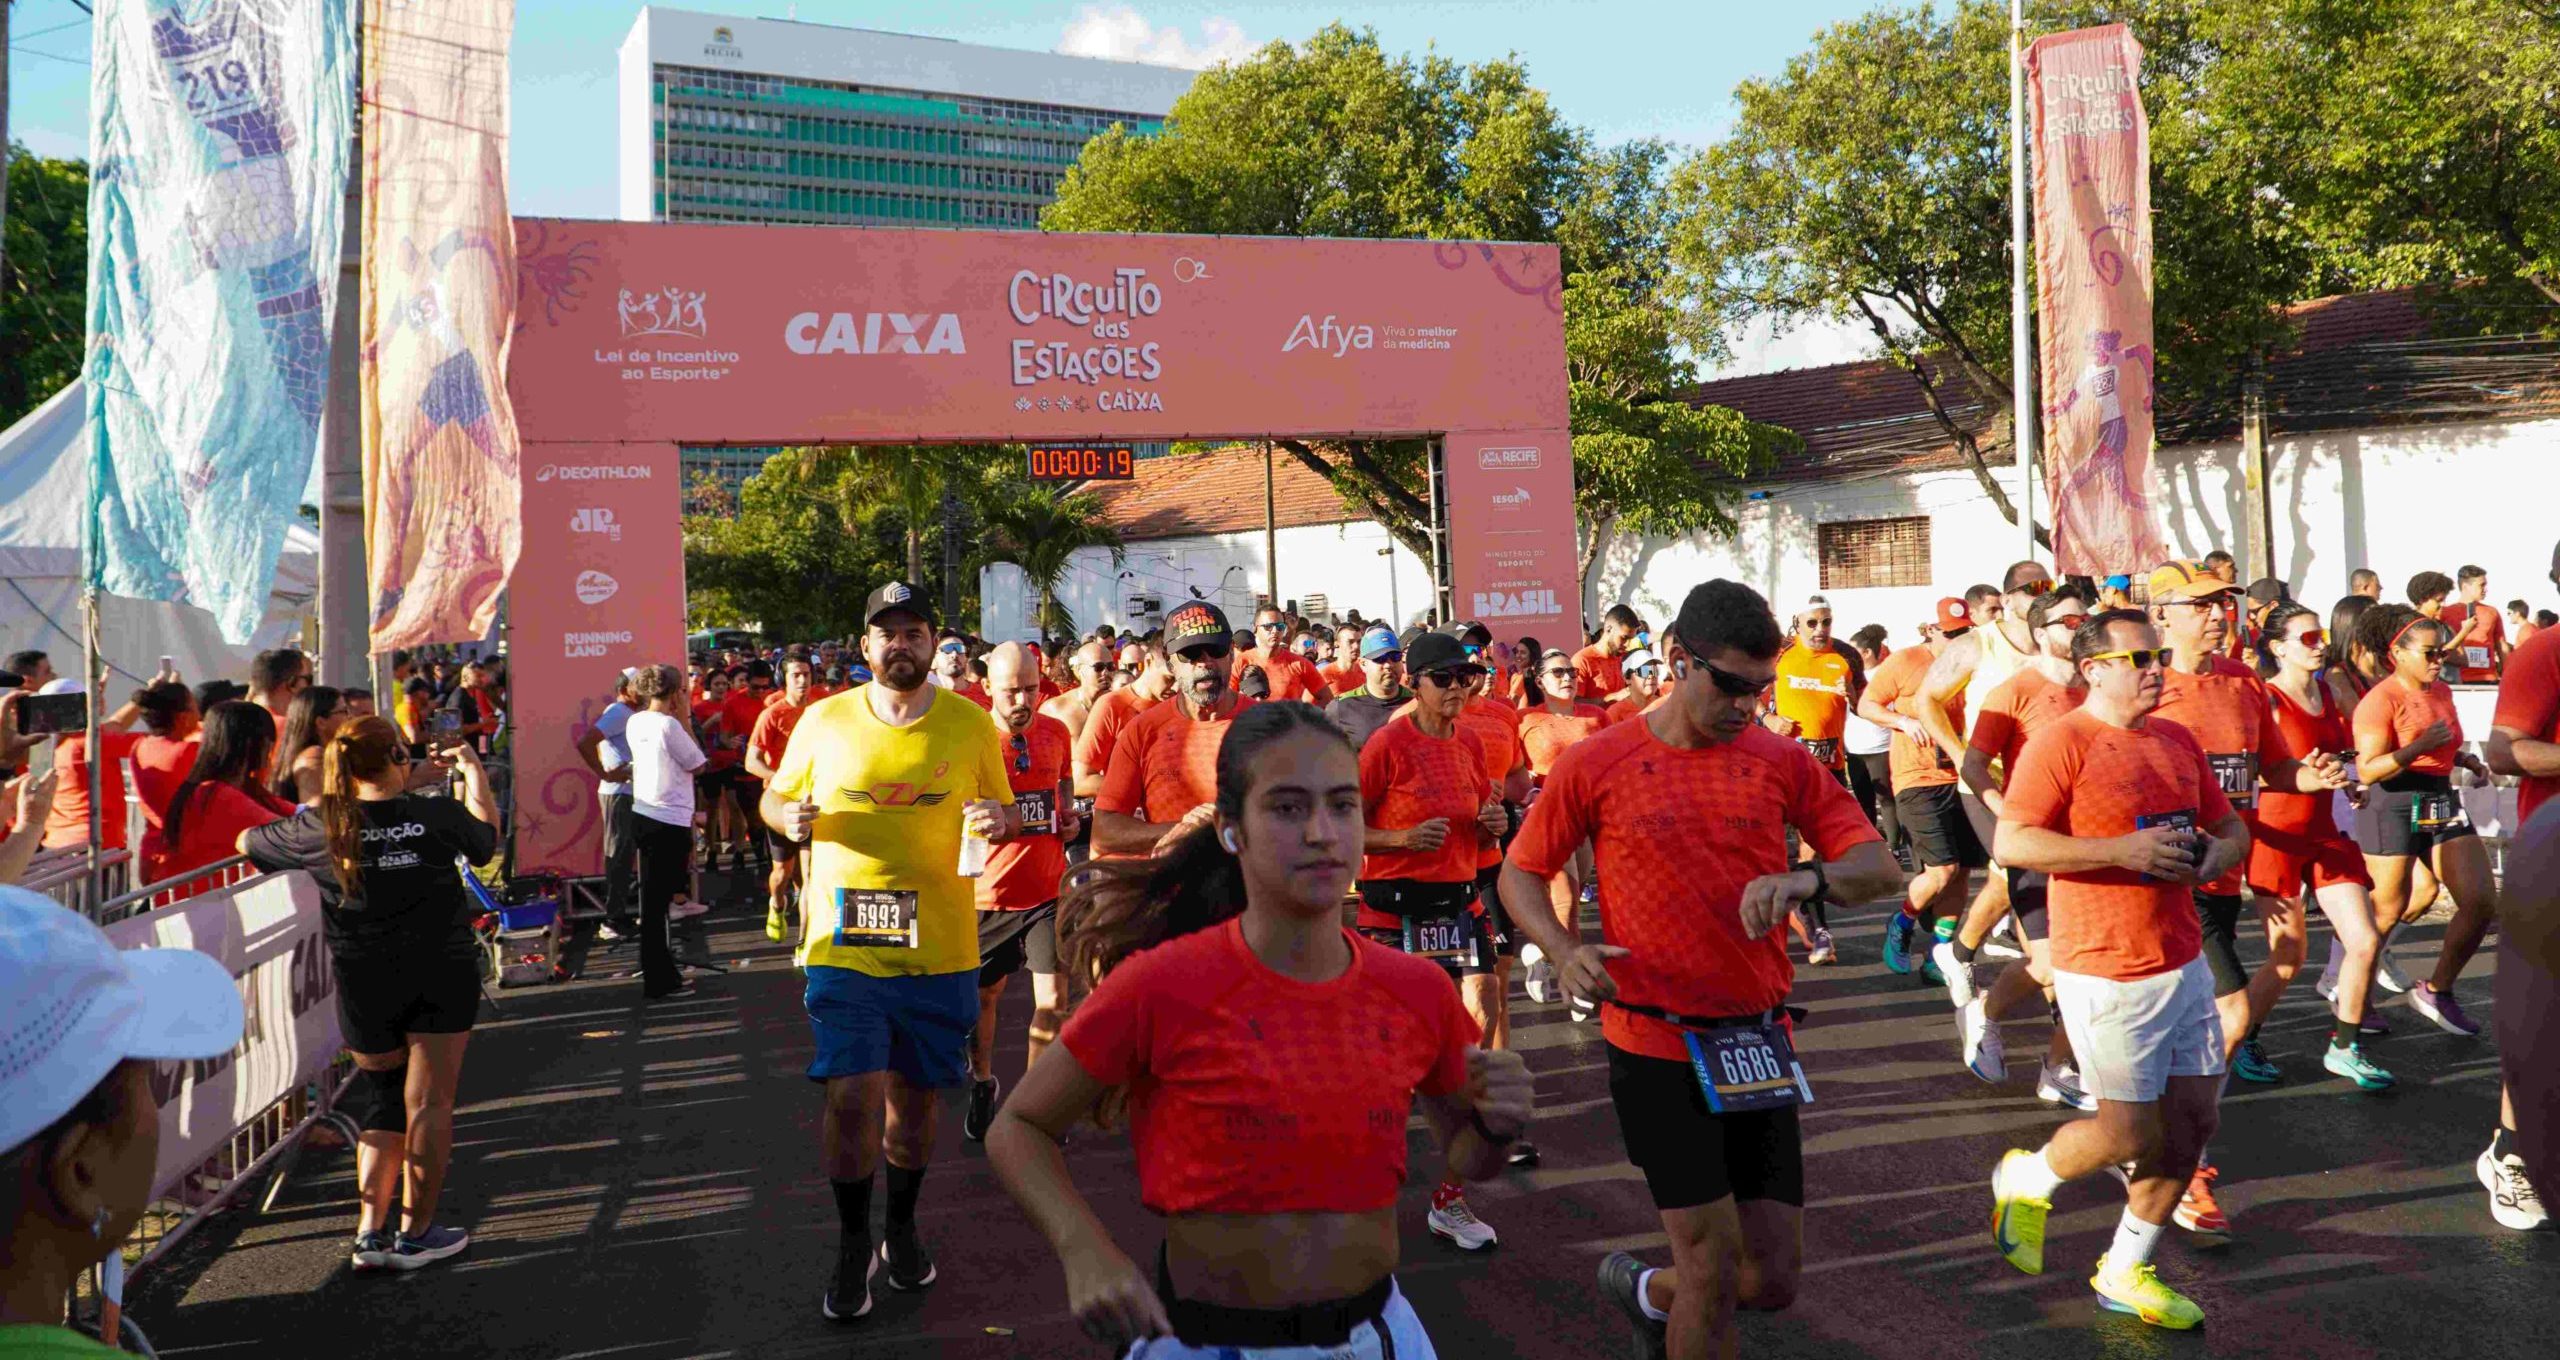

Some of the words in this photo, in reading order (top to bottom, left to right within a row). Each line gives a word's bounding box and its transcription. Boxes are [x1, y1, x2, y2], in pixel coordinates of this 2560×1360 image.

[177, 60, 248, 110] 219
[784, 312, 967, 355] CAIXA
[1093, 317, 1130, 339] das
[1281, 314, 1375, 358] Afya
[1382, 325, 1406, 337] Viva
[1408, 328, 1415, 336] o
[1417, 326, 1458, 337] melhor
[1383, 338, 1397, 349] da
[1399, 338, 1451, 350] medicina
[594, 349, 623, 362] Lei
[628, 350, 651, 363] de
[656, 350, 740, 363] Incentivo
[1012, 339, 1162, 385] ESTAÇÕES
[622, 368, 644, 380] ao
[1032, 450, 1131, 476] 00:00:19
[1503, 451, 1537, 462] RECIFE
[560, 466, 651, 479] DECATHLON
[1498, 559, 1534, 568] ESPORTE
[1472, 589, 1563, 618] BRASIL
[1178, 614, 1216, 635] RUN
[564, 630, 633, 645] RUNNING
[564, 643, 607, 658] LAND
[2214, 768, 2248, 793] 7210
[360, 822, 425, 841] ODUÇÃO
[857, 903, 900, 929] 6993
[1420, 926, 1461, 951] 6304
[1720, 1045, 1781, 1085] 6686
